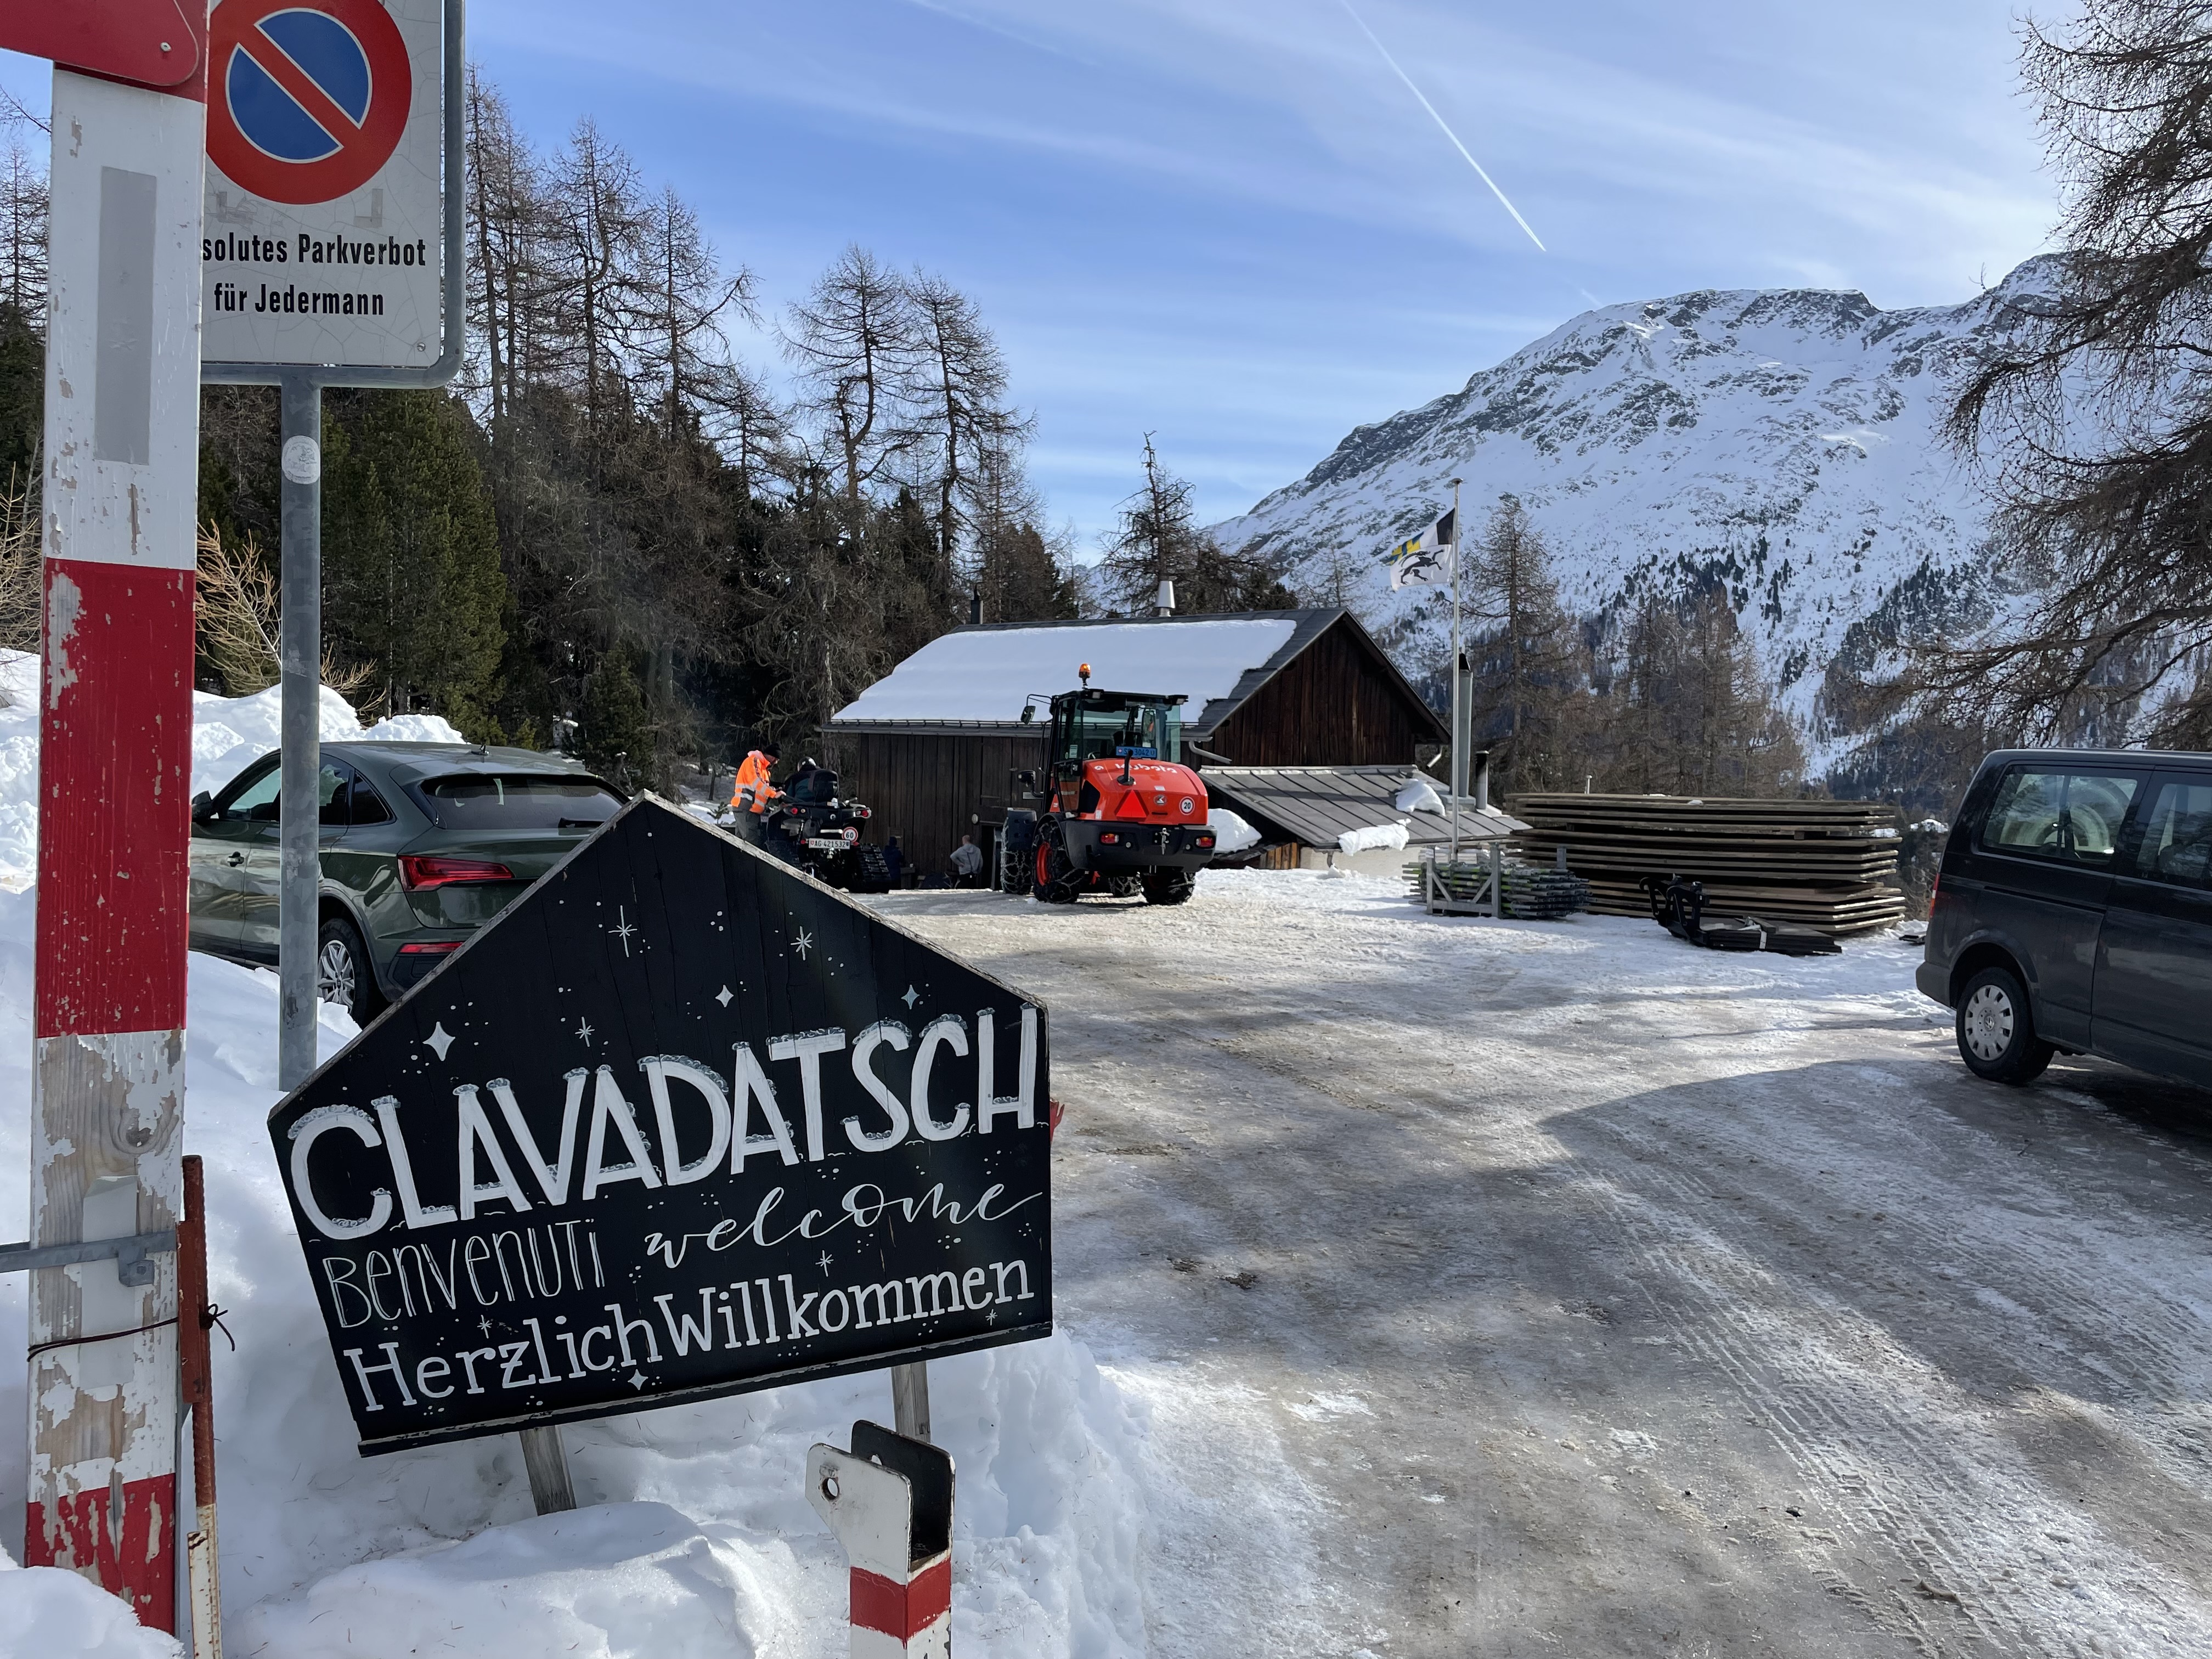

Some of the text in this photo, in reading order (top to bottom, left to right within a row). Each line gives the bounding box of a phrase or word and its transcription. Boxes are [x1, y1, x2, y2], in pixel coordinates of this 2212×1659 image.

[202, 232, 426, 266] solutes Parkverbot
[214, 283, 384, 315] für Jedermann
[287, 1003, 1037, 1240] CLAVADATSCH
[645, 1183, 1043, 1268] welcome
